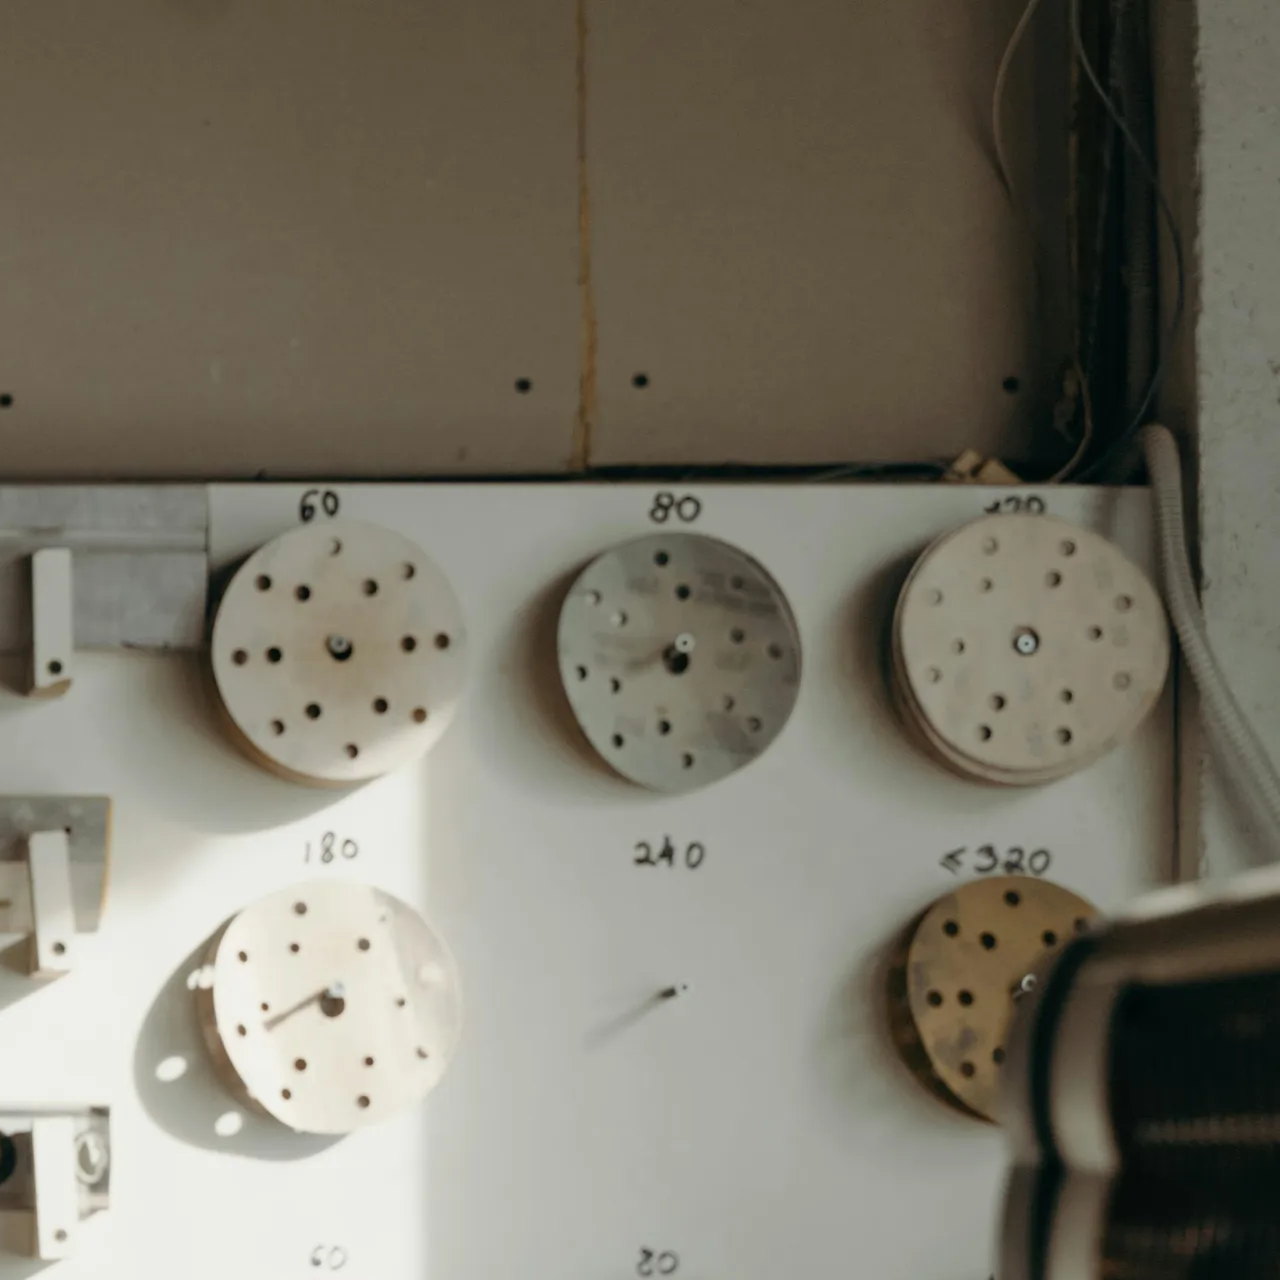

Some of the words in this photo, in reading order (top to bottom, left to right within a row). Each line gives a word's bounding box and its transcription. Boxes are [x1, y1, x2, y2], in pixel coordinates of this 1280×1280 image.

[299, 490, 340, 523] 60
[648, 491, 701, 524] 80
[303, 830, 360, 864] 180
[633, 833, 705, 869] 240
[308, 1242, 348, 1271] 60
